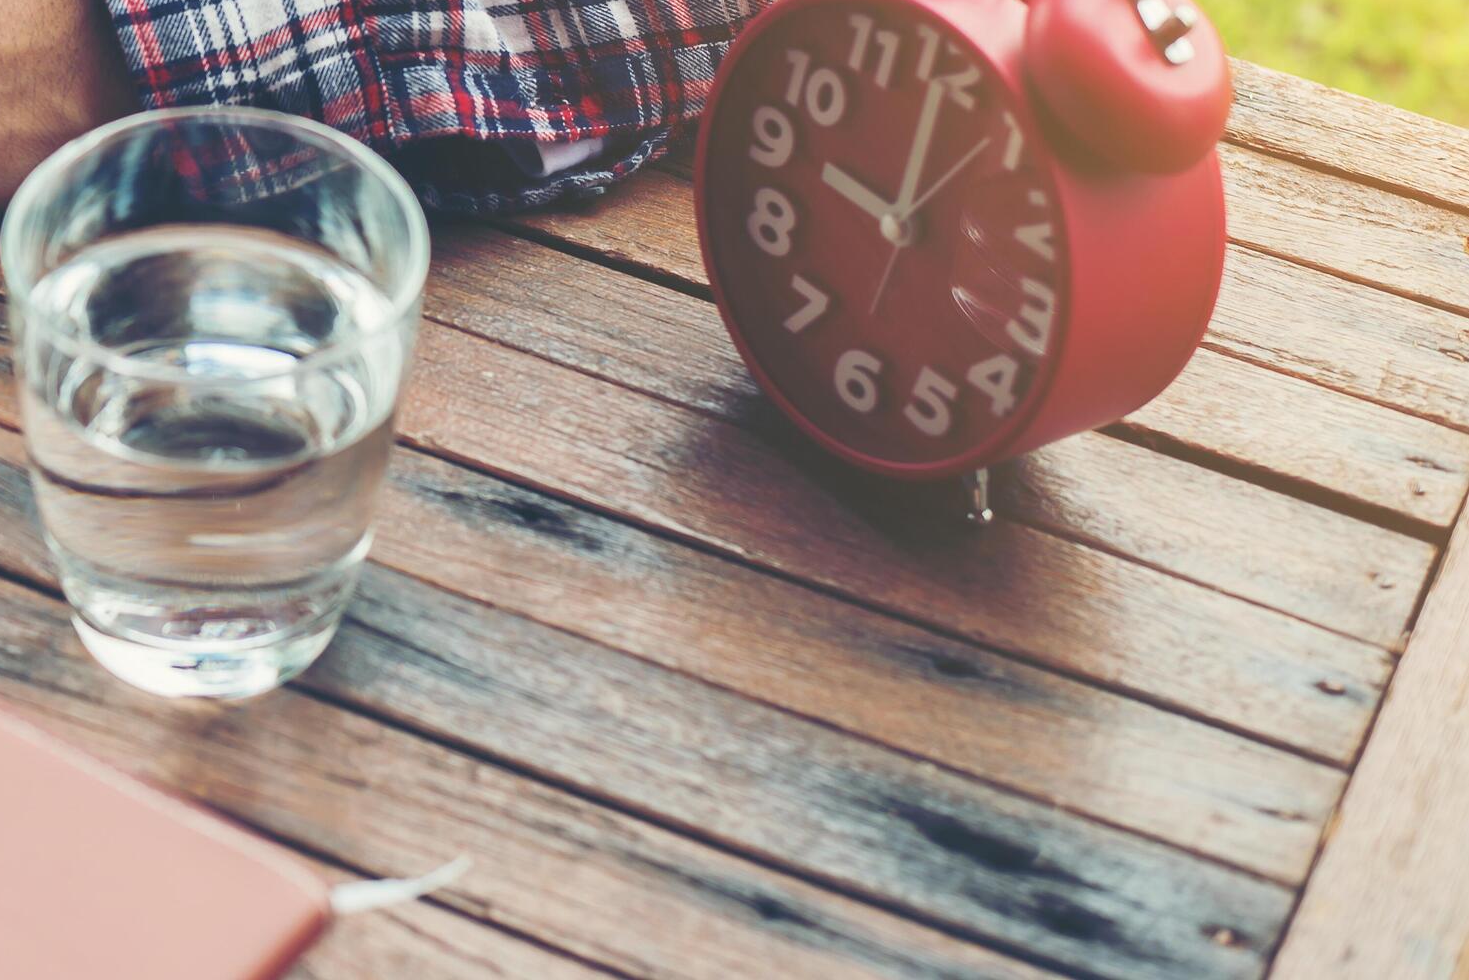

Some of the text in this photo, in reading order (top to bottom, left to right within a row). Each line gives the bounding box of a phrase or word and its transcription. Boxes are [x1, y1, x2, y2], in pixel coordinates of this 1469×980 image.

[848, 14, 901, 88] 11
[916, 24, 980, 110] 12
[785, 49, 845, 127] 10
[749, 105, 794, 169] 9
[746, 187, 797, 257] 8
[783, 274, 829, 334] 7
[834, 349, 882, 413] 6
[903, 366, 958, 436] 5
[966, 353, 1019, 416] 4
